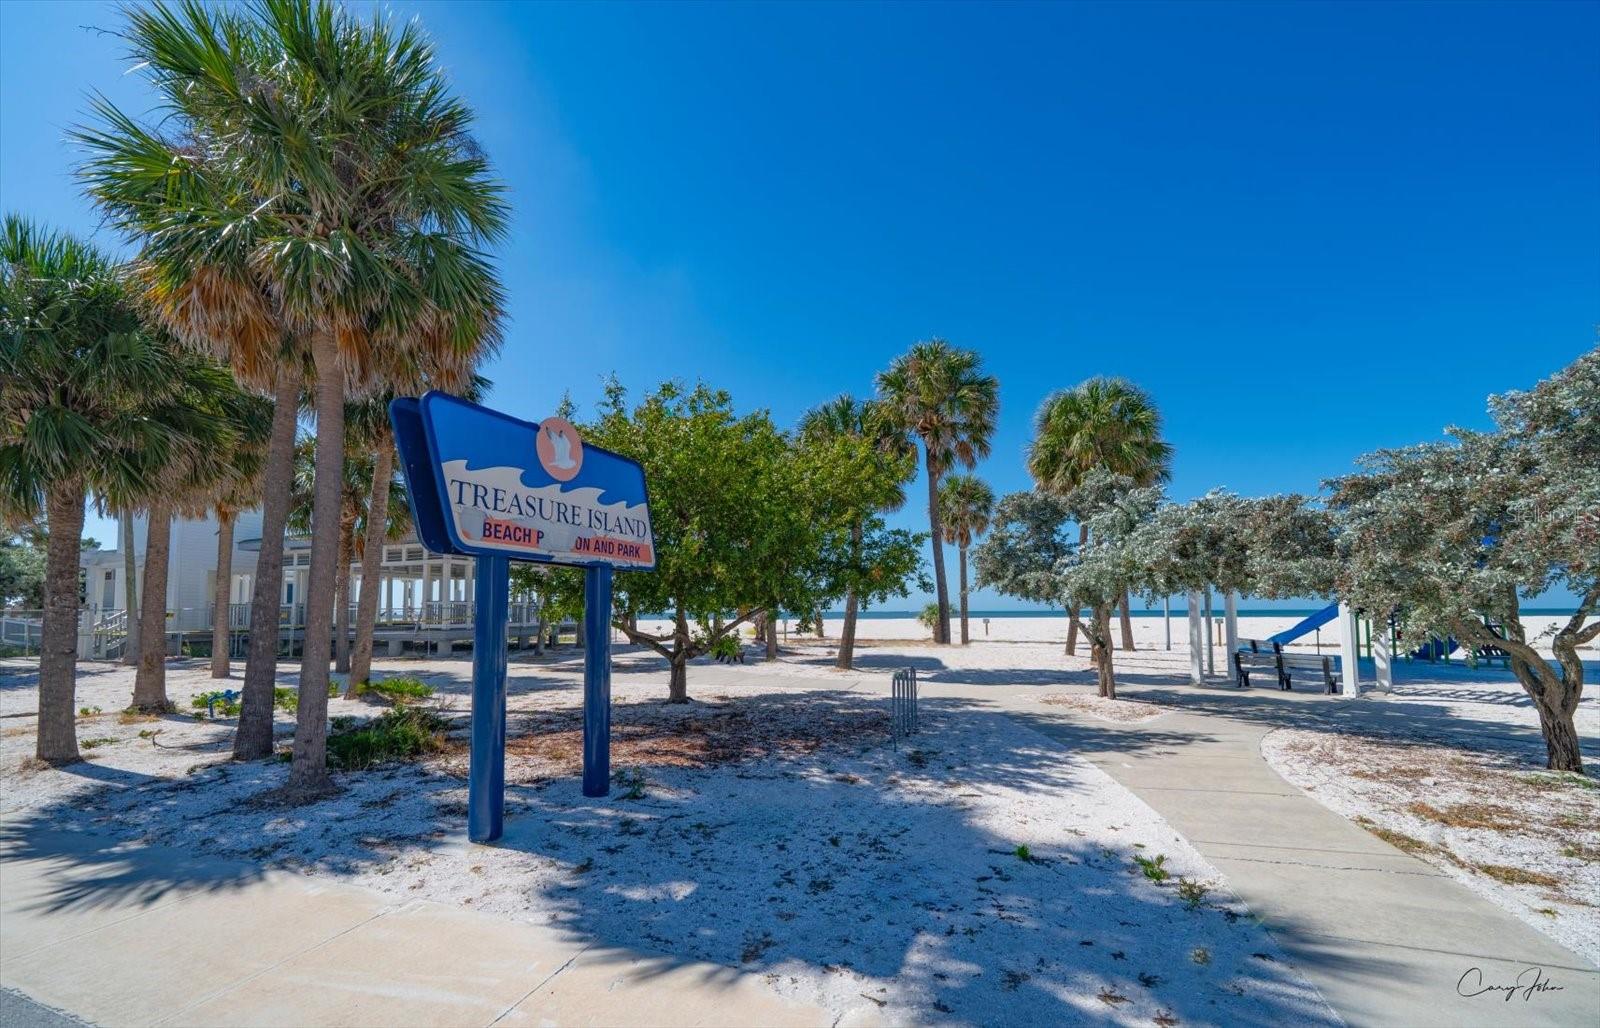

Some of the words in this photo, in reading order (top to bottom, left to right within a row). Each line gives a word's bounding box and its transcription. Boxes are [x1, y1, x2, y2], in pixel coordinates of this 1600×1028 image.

[450, 479, 581, 525] TREASURE
[588, 508, 647, 538] ISLAND
[482, 521, 532, 543] BEACH
[593, 540, 615, 554] AND
[617, 543, 641, 558] PARK
